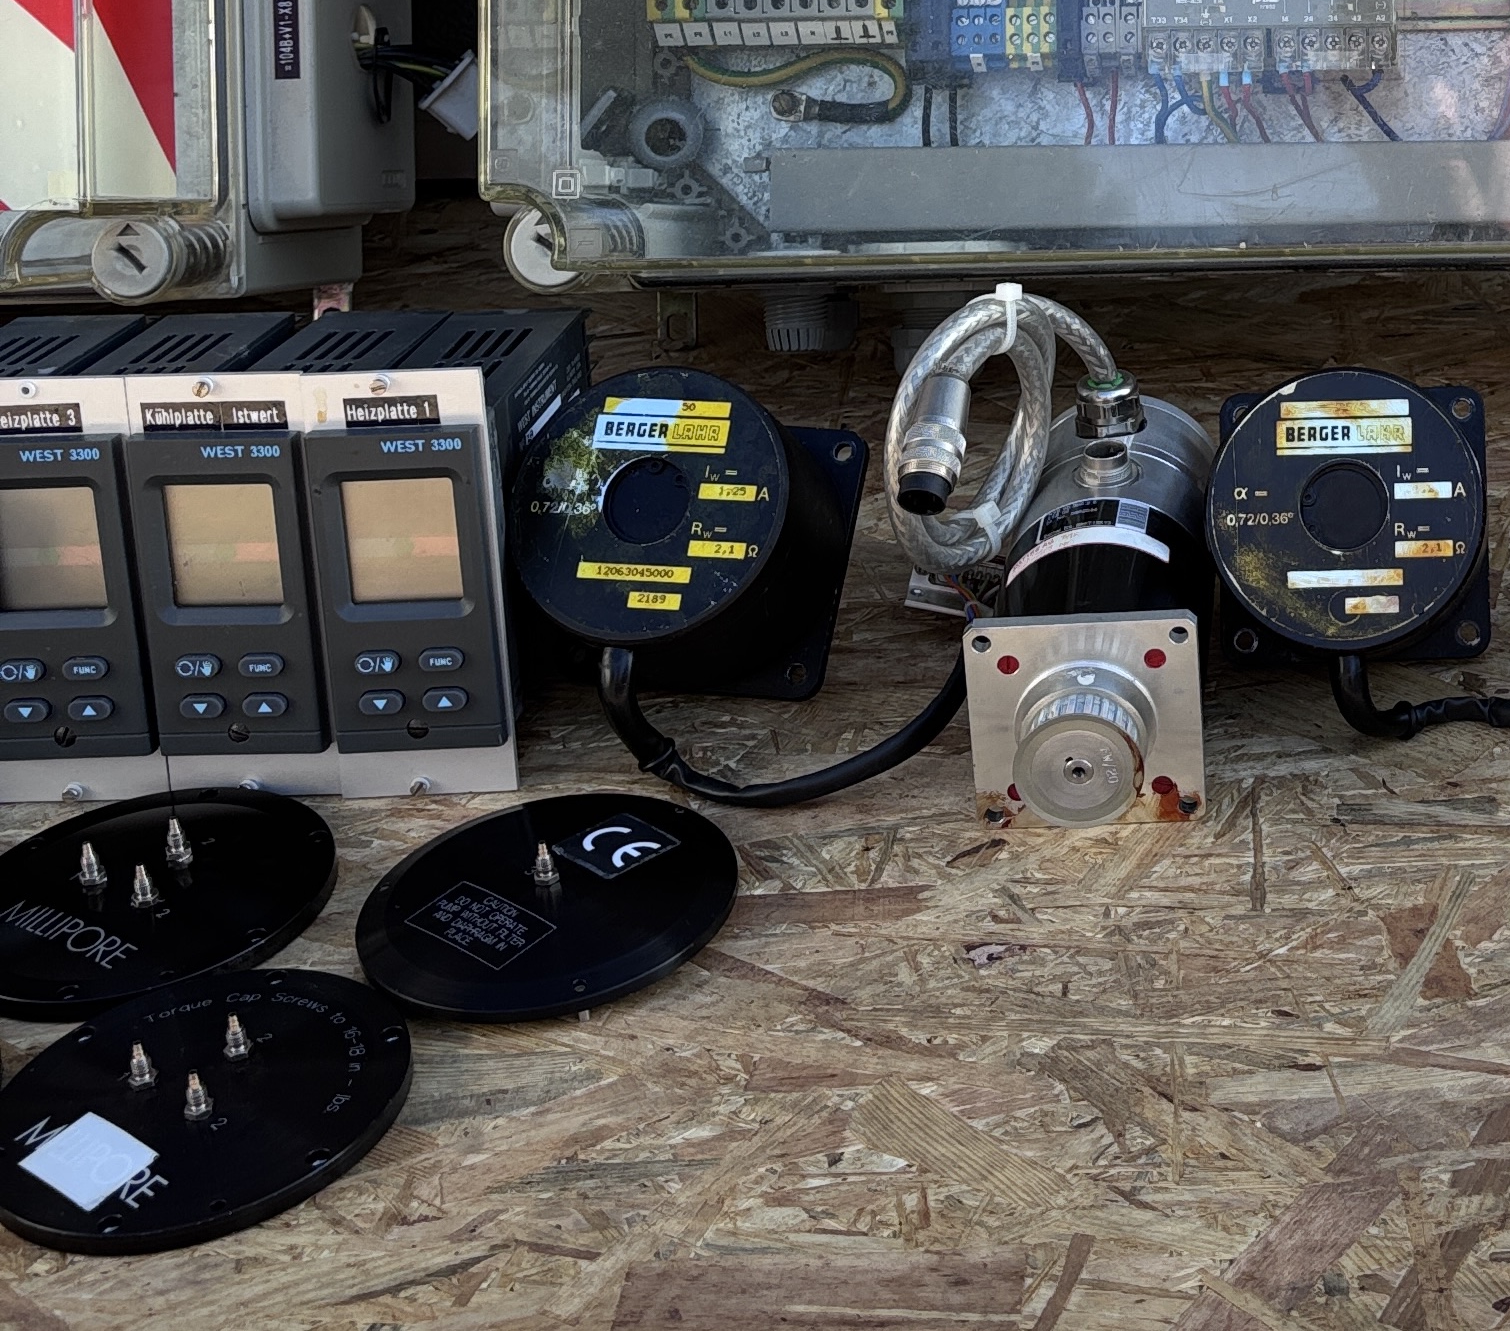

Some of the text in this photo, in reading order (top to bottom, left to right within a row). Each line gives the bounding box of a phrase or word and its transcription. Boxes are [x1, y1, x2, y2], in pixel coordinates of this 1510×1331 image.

[0, 408, 76, 430] eizplatte 3
[145, 407, 214, 427] Kühlplatte
[232, 407, 279, 423] Istwert
[346, 401, 430, 423] Heizplatte 1
[604, 420, 721, 441] BERGER LAHR
[1285, 424, 1407, 442] BERGER LAHR
[200, 445, 281, 459] WEST 3300
[380, 438, 462, 453] WEST 3300
[19, 447, 100, 463] WEST 3300
[757, 488, 770, 502] A
[1453, 482, 1466, 497] A
[713, 544, 759, 558] 2,1 Ω
[1455, 542, 1466, 554] Ω
[595, 565, 674, 579] 12063045000
[637, 593, 667, 604] 2189
[73, 664, 97, 675] FUNC
[248, 662, 273, 673] FUNC
[429, 656, 453, 667] FUNC
[484, 896, 519, 919] CAUTION
[468, 901, 491, 917] NOT
[488, 910, 529, 936] OPERATE
[0, 899, 139, 969] MILLIPORE
[443, 926, 474, 946] PLACE
[460, 908, 498, 933] WITHOUT
[495, 927, 527, 948] FILTER
[144, 998, 213, 1023] Torque
[226, 992, 262, 1004] Cap
[270, 992, 329, 1013] Screws
[329, 1011, 346, 1025] to
